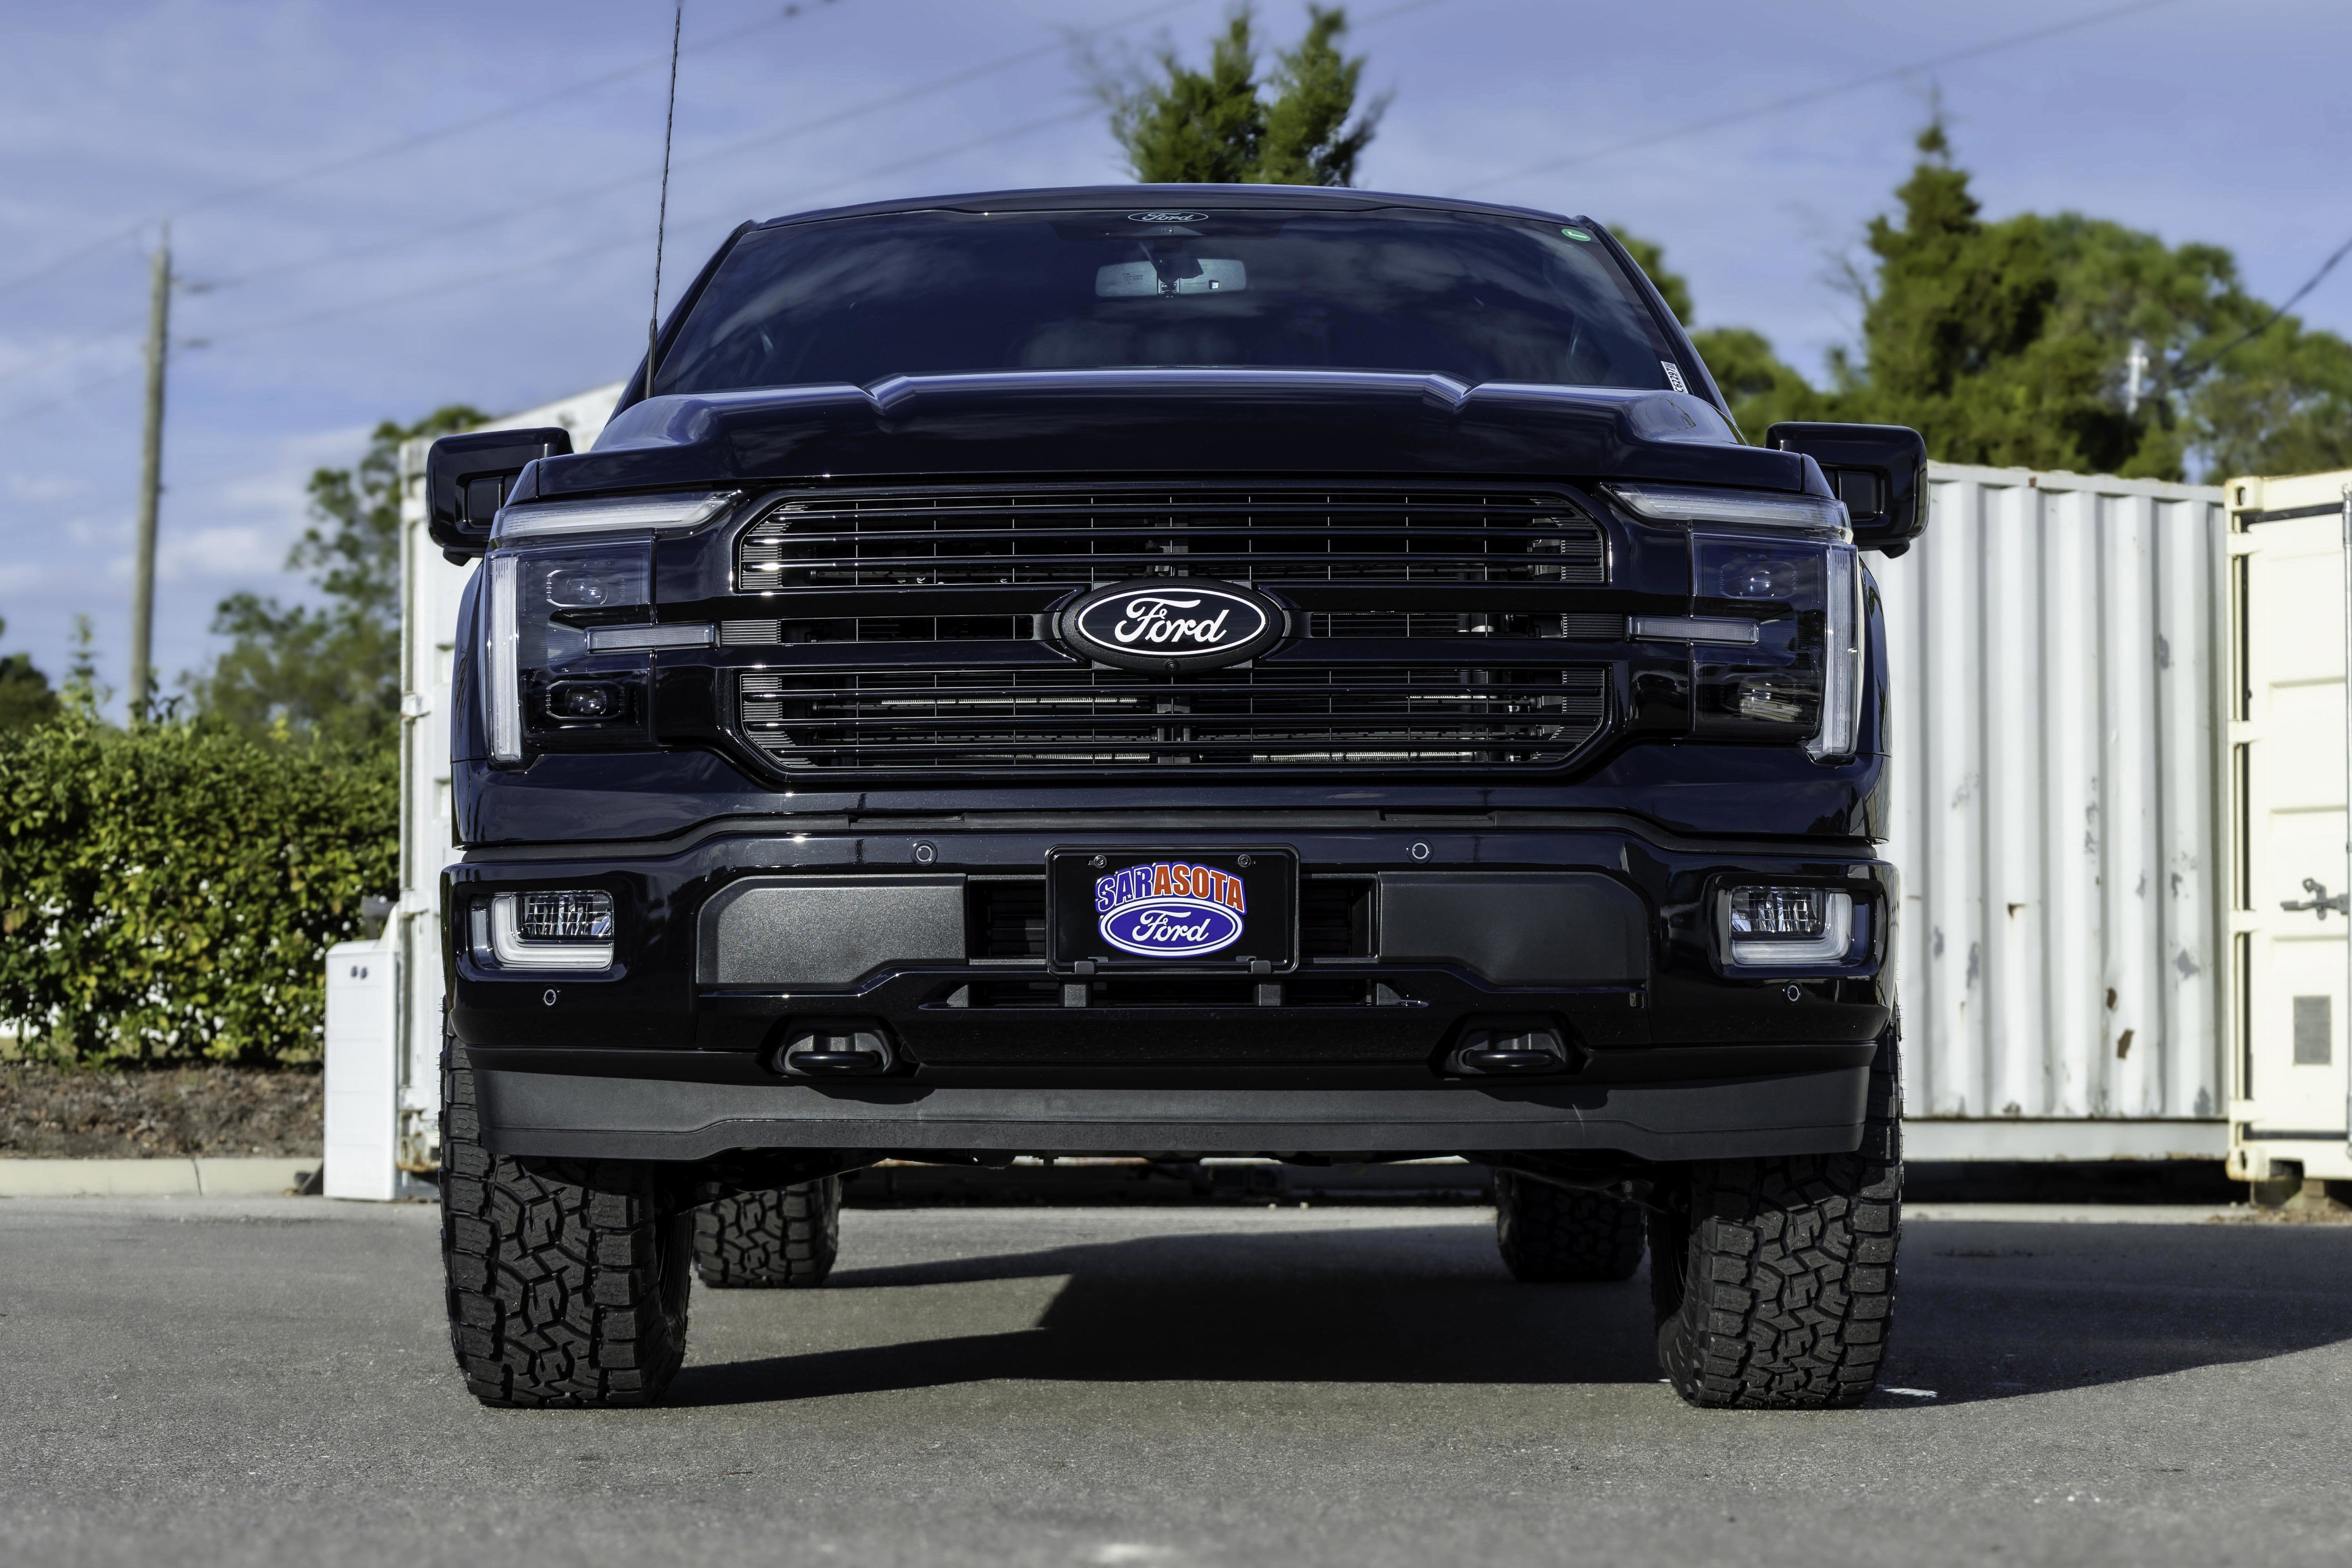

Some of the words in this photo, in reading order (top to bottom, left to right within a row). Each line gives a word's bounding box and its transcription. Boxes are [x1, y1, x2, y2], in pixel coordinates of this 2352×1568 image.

[1666, 368, 1684, 392] C62297
[1114, 597, 1229, 643] Ford
[1097, 864, 1246, 913] SARASOTA
[1131, 910, 1212, 942] Ford
